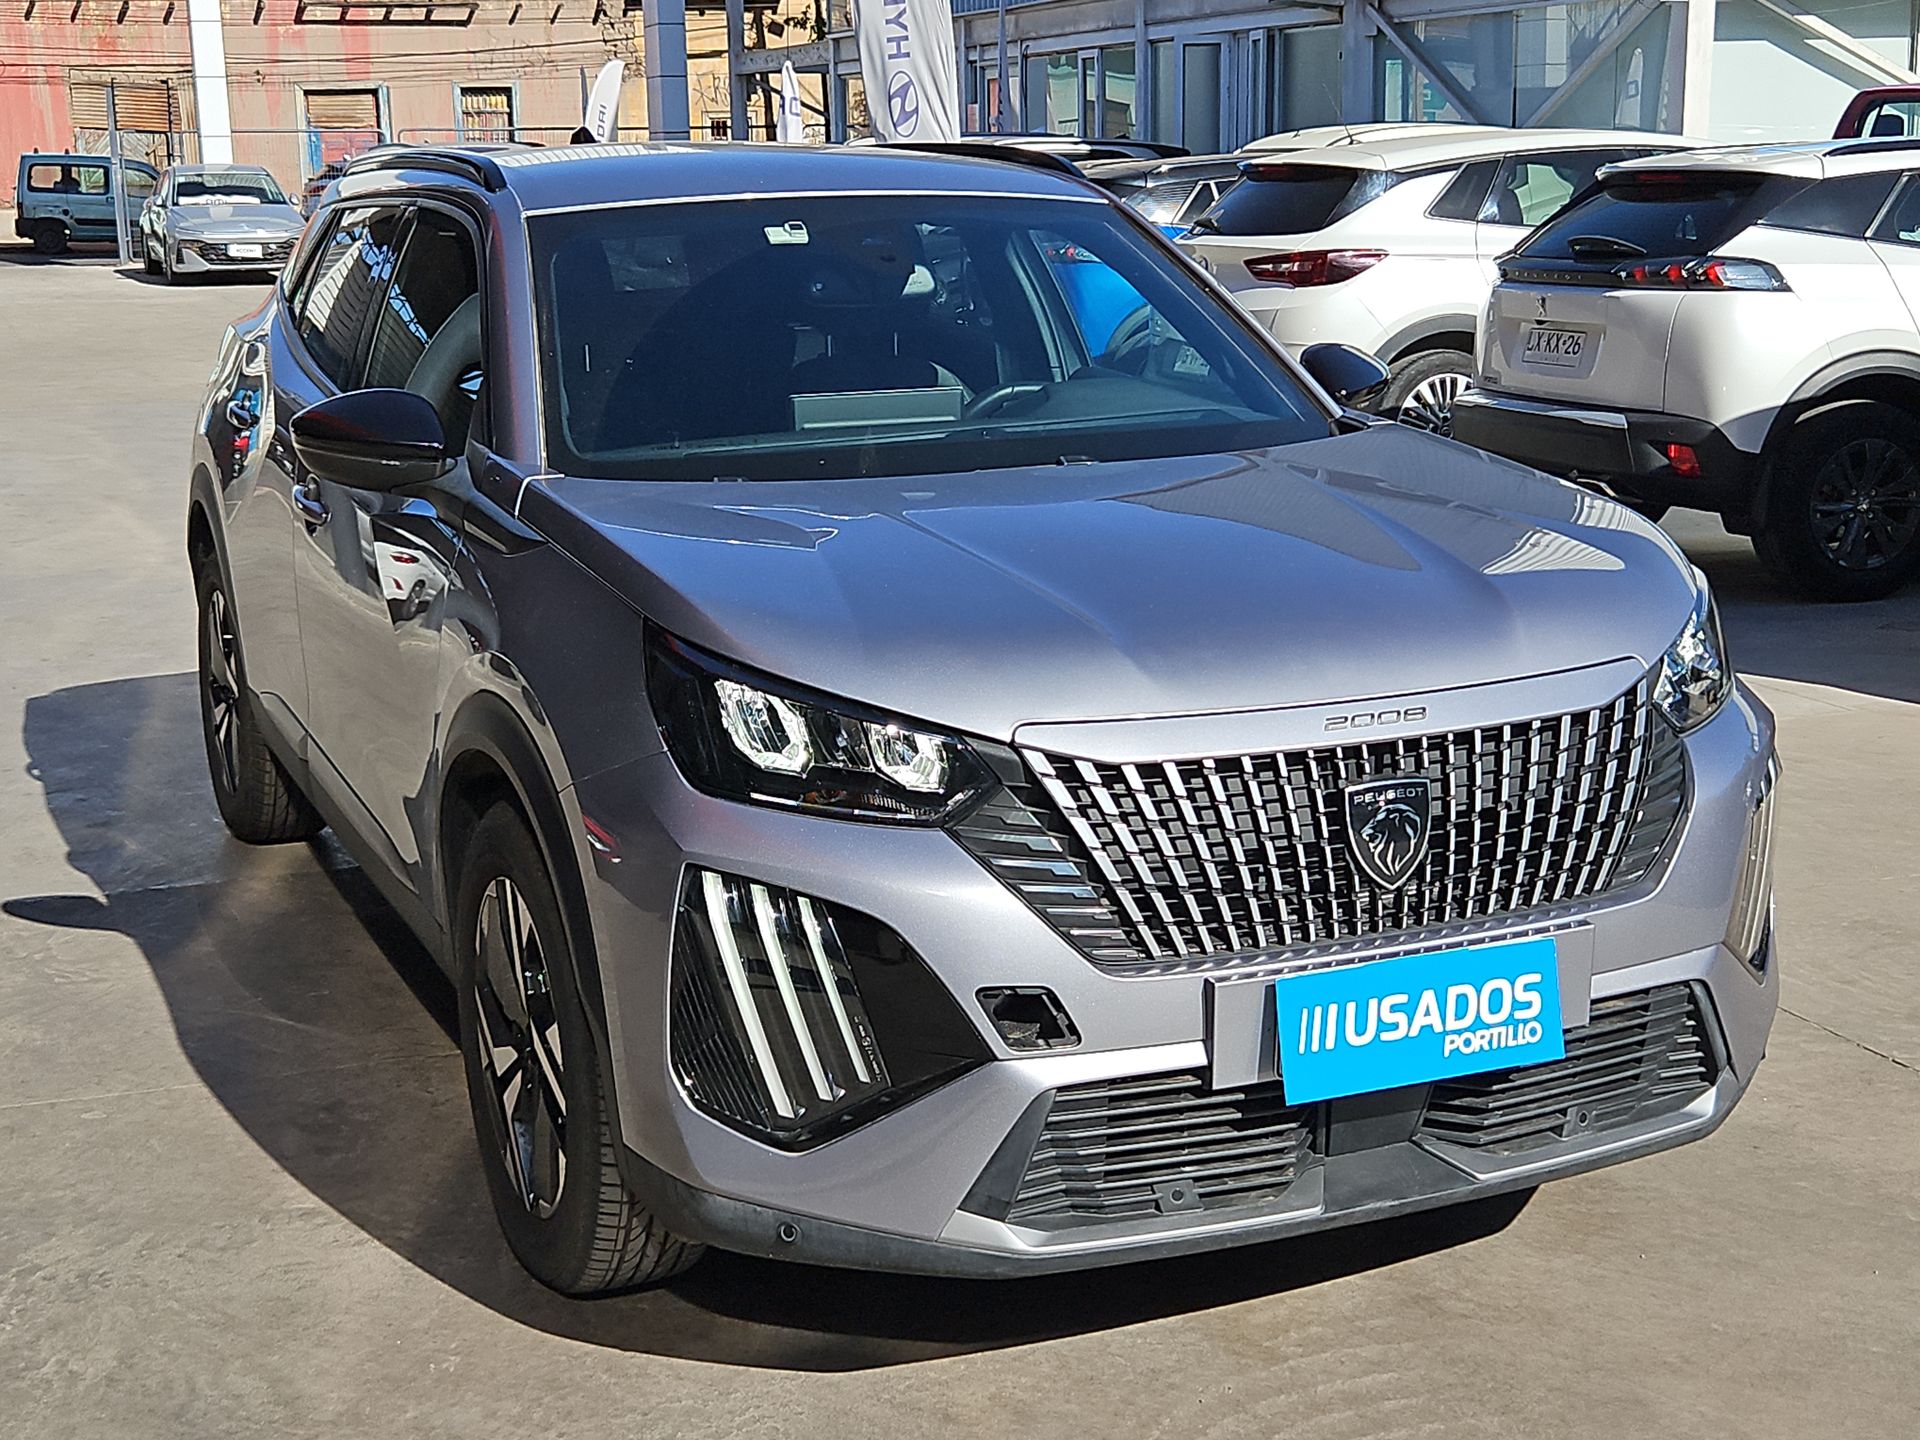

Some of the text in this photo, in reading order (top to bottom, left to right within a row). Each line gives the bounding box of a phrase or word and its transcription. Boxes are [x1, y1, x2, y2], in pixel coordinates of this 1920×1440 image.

[597, 104, 607, 142] DAI
[1324, 706, 1427, 732] 2008
[1353, 787, 1425, 805] PEUGEOT
